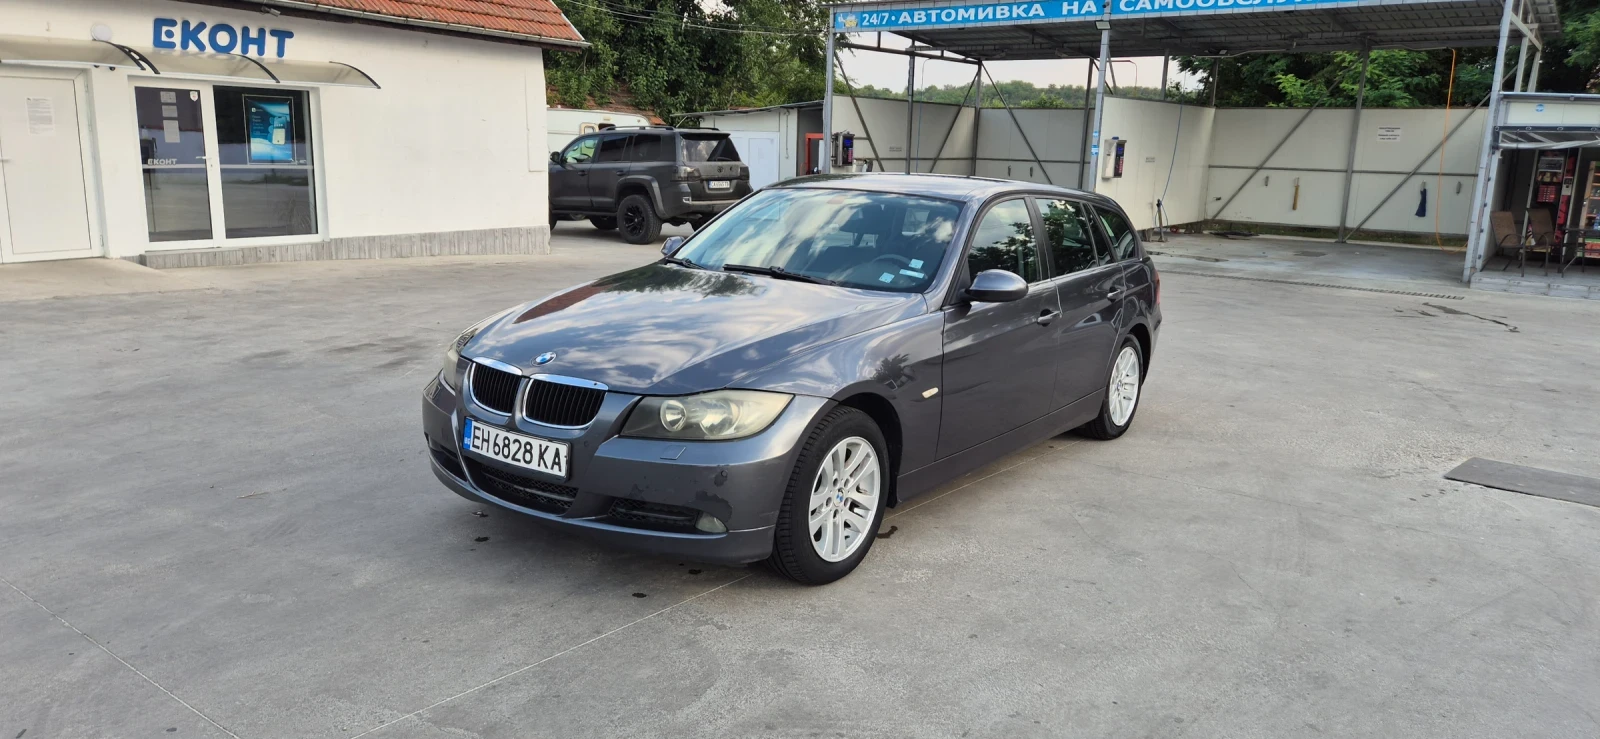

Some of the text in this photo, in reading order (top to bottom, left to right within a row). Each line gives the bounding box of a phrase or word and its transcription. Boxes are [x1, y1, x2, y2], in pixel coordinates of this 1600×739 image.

[862, 13, 889, 25] 24/7
[898, 4, 1045, 24] АВТОМИВКА
[1061, 0, 1097, 15] НА
[153, 17, 294, 58] ЕКОНТ
[147, 158, 177, 166] ЕКОНТ
